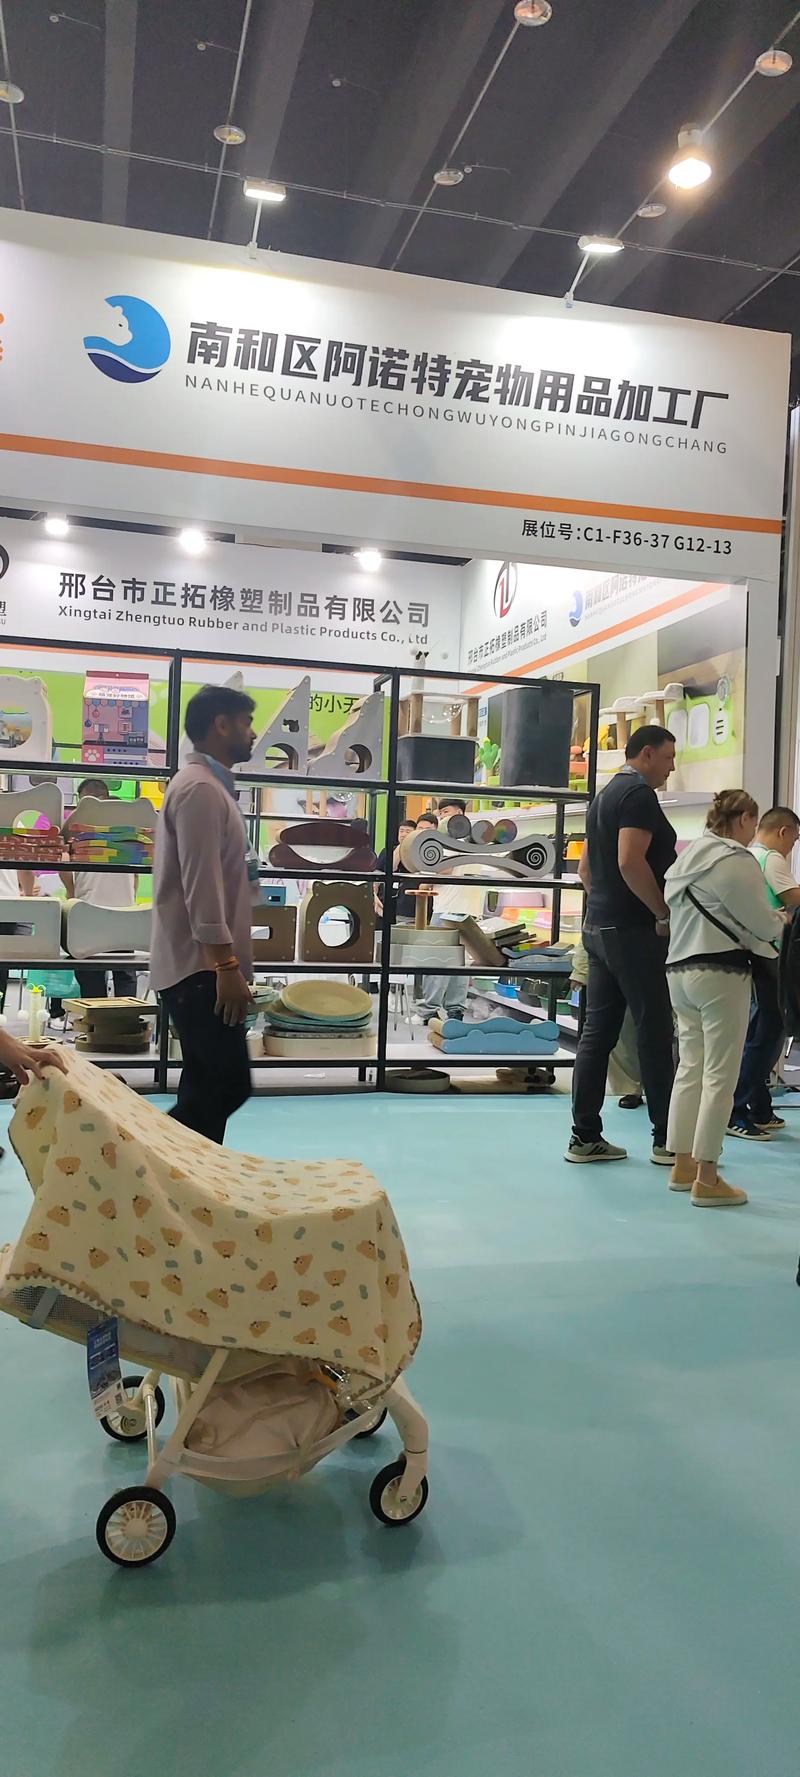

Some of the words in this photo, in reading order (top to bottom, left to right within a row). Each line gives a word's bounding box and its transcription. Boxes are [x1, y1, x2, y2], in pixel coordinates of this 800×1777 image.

[186, 321, 729, 429] 南和区阿诺特宠物用品加工厂
[185, 374, 728, 454] NANHEQUANUOTECHONGWUYONGPINJIAGONGCHANG
[674, 535, 732, 555] G12-13
[58, 571, 430, 629] 邢台市正拓橡塑制品有限公司
[58, 605, 112, 621] Xingtai
[115, 610, 185, 626] Zhengtuo
[188, 616, 239, 630] Rubber
[241, 621, 269, 633] and
[271, 622, 316, 637] Plastic
[319, 626, 377, 641] Products
[380, 631, 405, 645] Co.,
